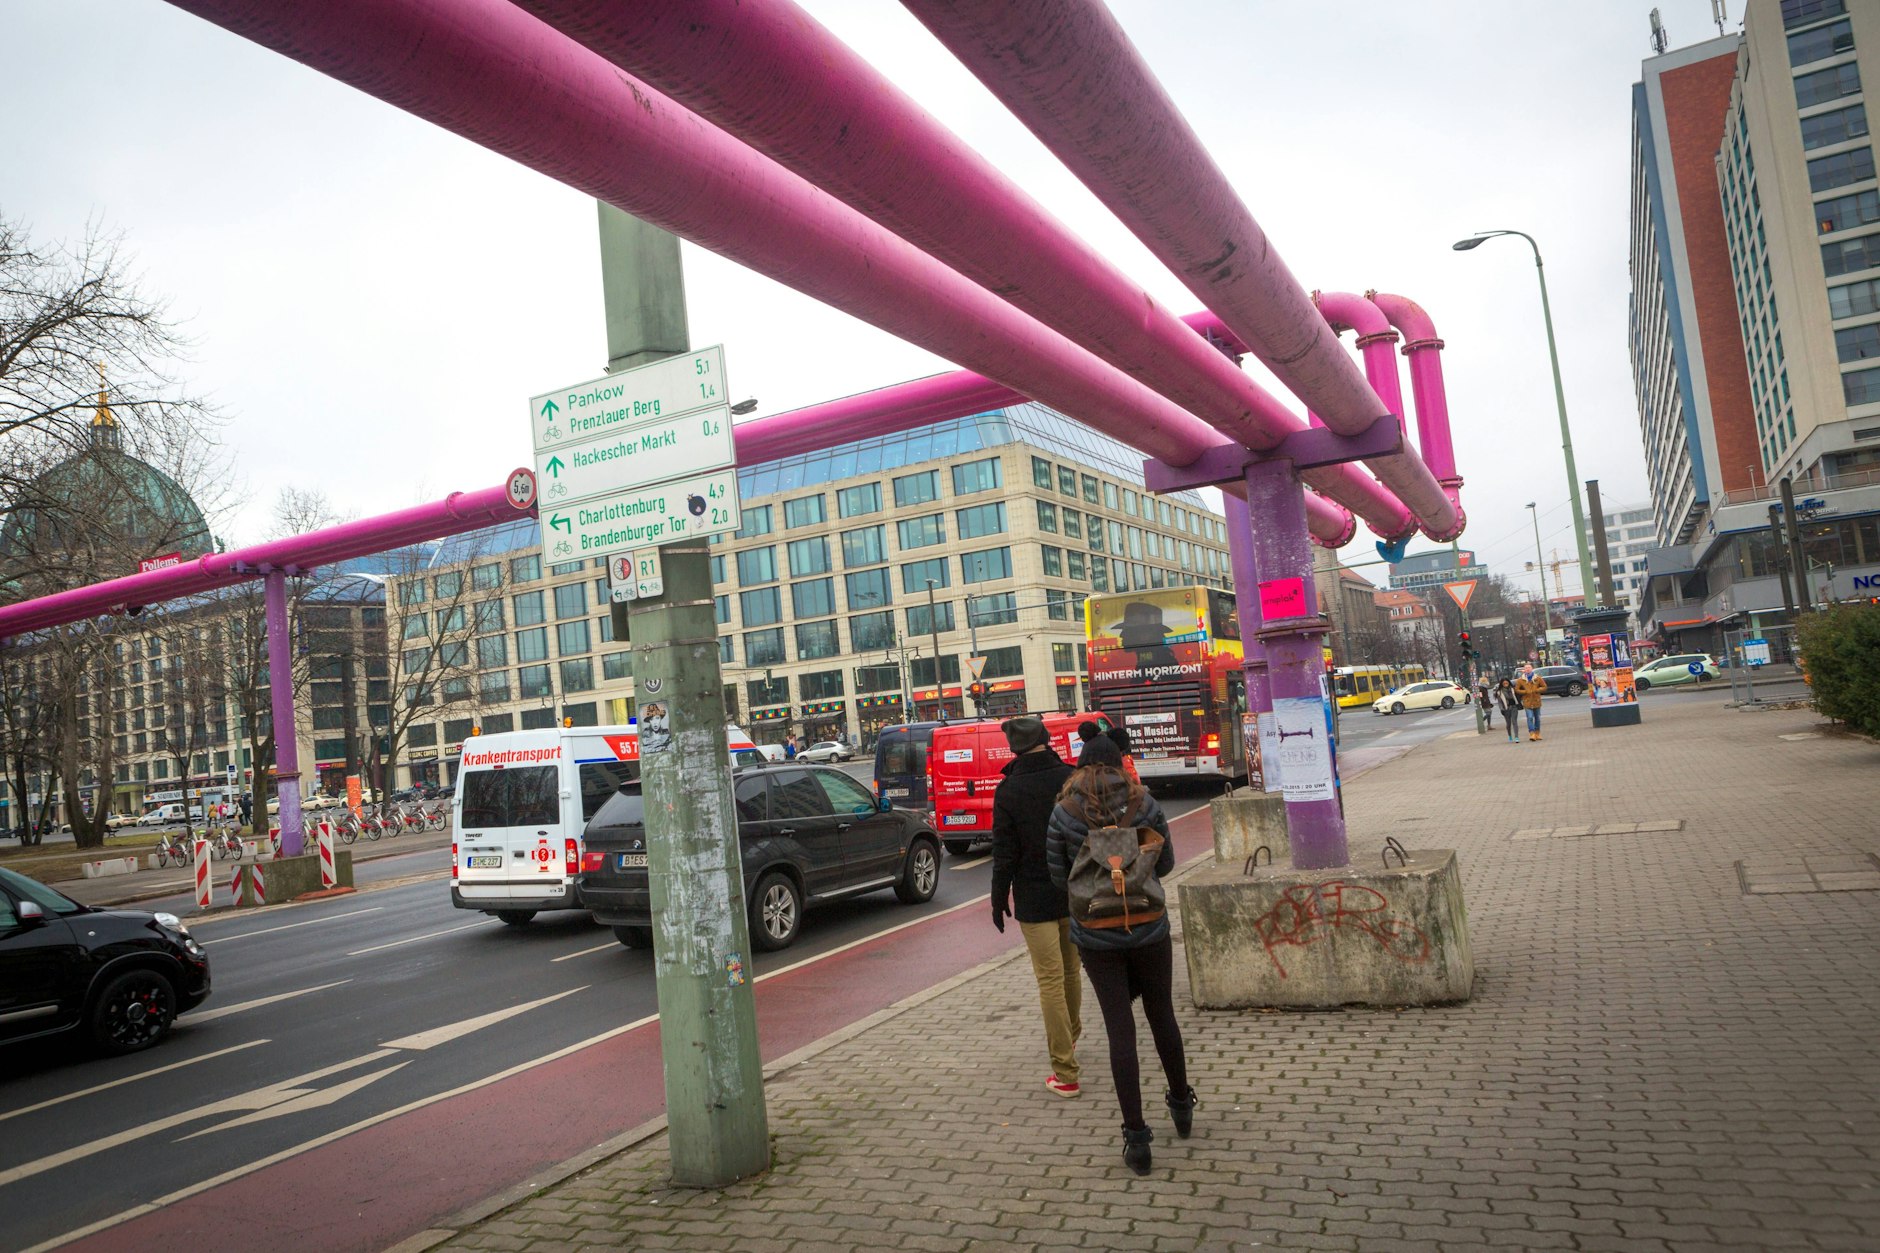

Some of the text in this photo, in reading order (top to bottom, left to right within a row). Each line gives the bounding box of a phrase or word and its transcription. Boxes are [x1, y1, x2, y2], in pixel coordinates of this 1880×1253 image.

[568, 384, 624, 411] Pankow
[570, 399, 661, 433] Prenzlauer Berg
[573, 429, 676, 468] Hackescher Markt
[579, 497, 665, 526] Charlottenburg
[581, 516, 686, 550] Brandenburger Tor
[141, 557, 179, 572] Pollems
[1094, 663, 1203, 681] HINTERM HORIZONT
[1143, 725, 1177, 736] Musical
[463, 745, 561, 767] Krankentransport
[619, 741, 632, 754] 55
